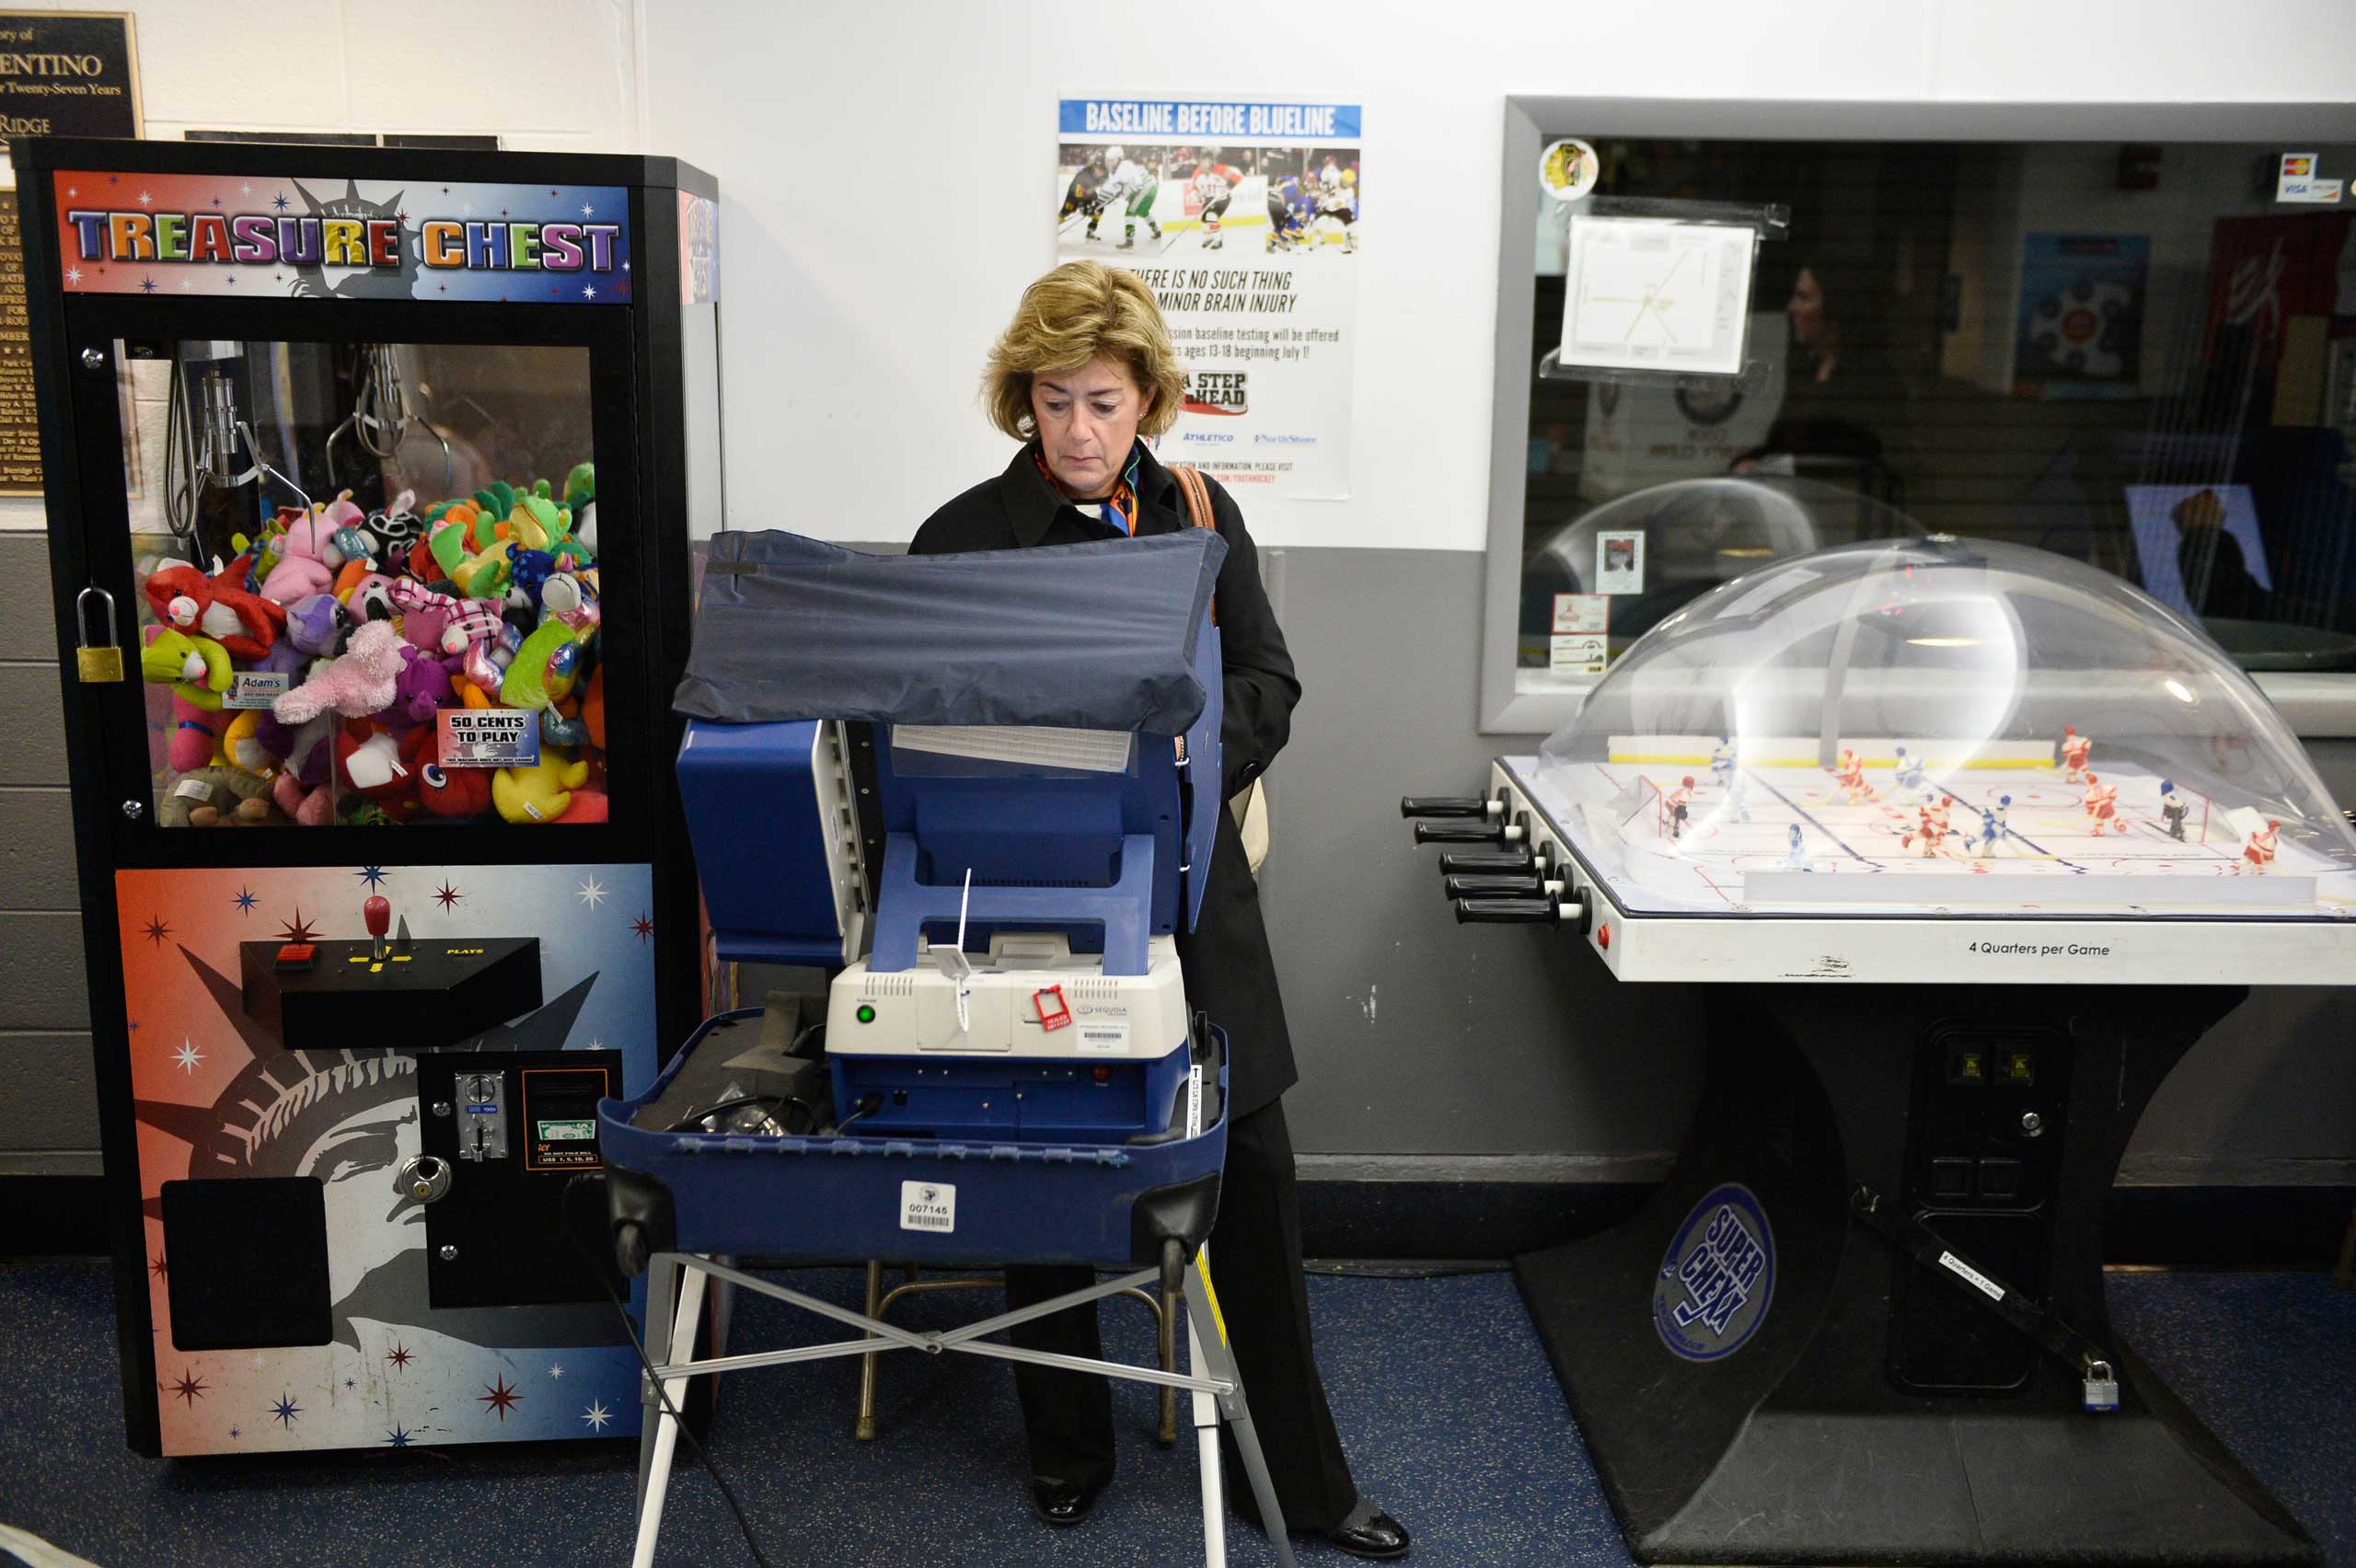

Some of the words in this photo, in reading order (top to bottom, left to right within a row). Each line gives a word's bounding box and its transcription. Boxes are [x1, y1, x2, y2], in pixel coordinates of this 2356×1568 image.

[19, 28, 35, 41] of
[8, 81, 87, 97] Twenty-Seven
[87, 83, 121, 96] Years
[1086, 102, 1173, 133] BASELINE
[1178, 105, 1246, 134] BEFORE
[1249, 106, 1336, 136] BLUELINE
[2285, 185, 2307, 193] VISA
[68, 211, 399, 267] TREASURE
[422, 220, 619, 271] CHEST
[1172, 270, 1186, 289] IS
[1189, 270, 1208, 290] NO
[1211, 271, 1248, 290] SUCH
[1252, 271, 1292, 290] THING
[1157, 292, 1201, 311] MINOR
[1204, 294, 1247, 312] BRAIN
[1249, 294, 1298, 313] INJURY
[1195, 328, 1234, 340] baseline
[1237, 329, 1270, 344] testing
[1273, 329, 1288, 341] will
[1292, 329, 1302, 341] be
[1305, 329, 1339, 342] offered
[1184, 346, 1206, 360] ages
[1208, 344, 1231, 357] 13-18
[1234, 345, 1280, 361] beginning
[1283, 345, 1299, 361] July
[1197, 373, 1246, 389] STEP
[1254, 462, 1276, 471] PLEASE
[1278, 463, 1293, 471] VISIT
[242, 677, 281, 687] Adam's
[451, 717, 472, 728] 50
[477, 717, 525, 728] CENTS
[457, 732, 476, 743] TO
[481, 732, 519, 743] PLAY
[1969, 941, 1977, 952] 4
[1981, 941, 2038, 954] Quarters
[2041, 944, 2063, 956] per
[2067, 943, 2110, 955] Game
[1705, 1205, 1766, 1295] SUPER
[1948, 1258, 1974, 1279] Quarters
[1984, 1283, 2002, 1298] Game
